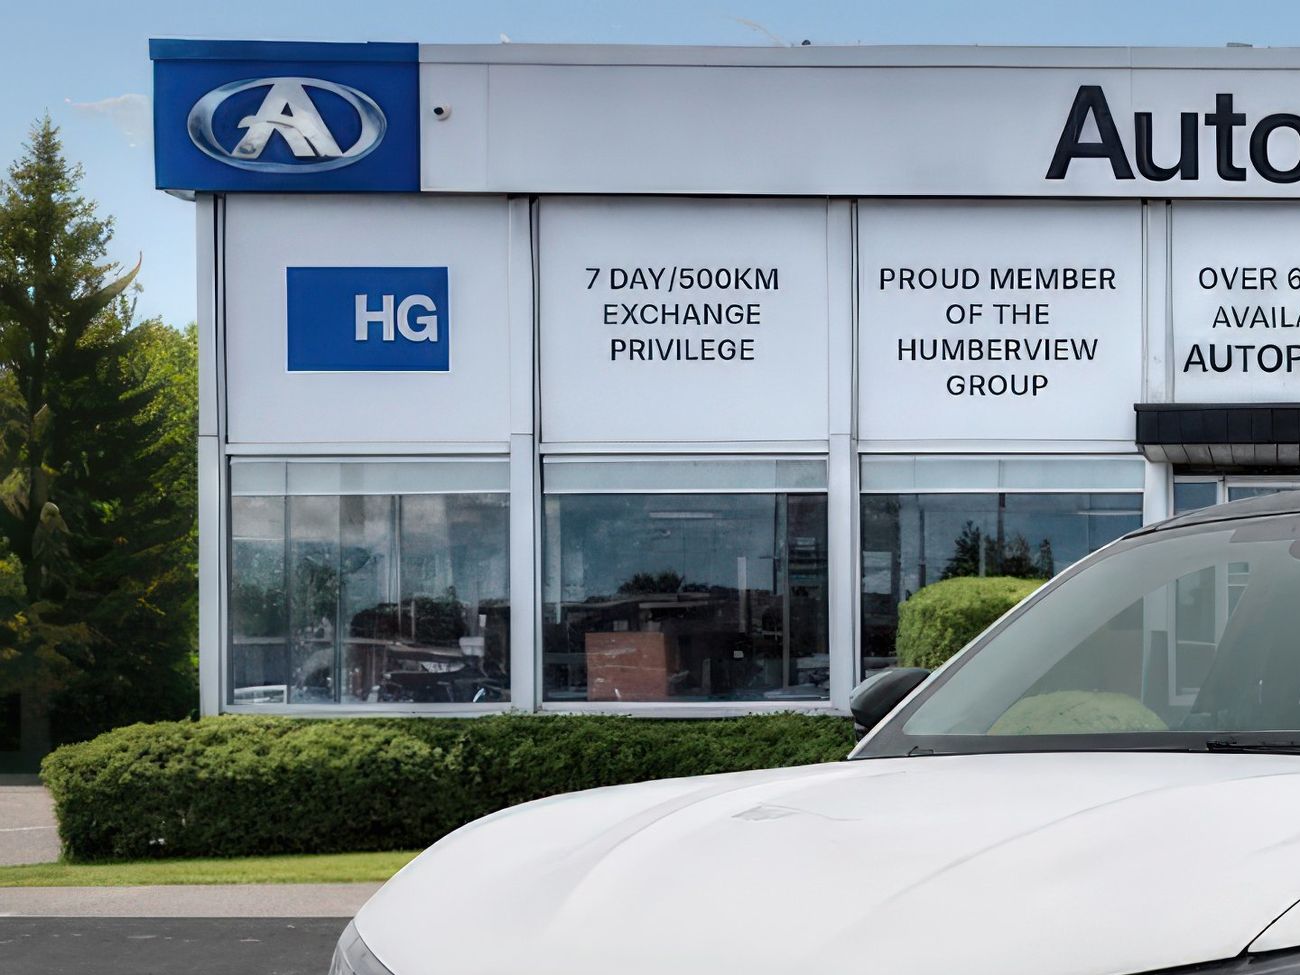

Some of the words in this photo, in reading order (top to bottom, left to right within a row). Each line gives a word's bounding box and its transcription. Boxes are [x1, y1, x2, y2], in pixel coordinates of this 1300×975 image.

[585, 267, 601, 290] 7
[610, 266, 779, 293] DAY/500KM
[880, 267, 980, 291] PROUD
[990, 267, 1116, 290] MEMBER
[1198, 266, 1278, 291] OVER
[354, 293, 439, 343] HG
[603, 303, 761, 326] EXCHANGE
[945, 303, 983, 325] OF
[992, 303, 1049, 325] THE
[611, 338, 755, 361] PRIVILEGE
[898, 338, 1099, 361] HUMBERVIEW
[946, 374, 1049, 397] GROUP
